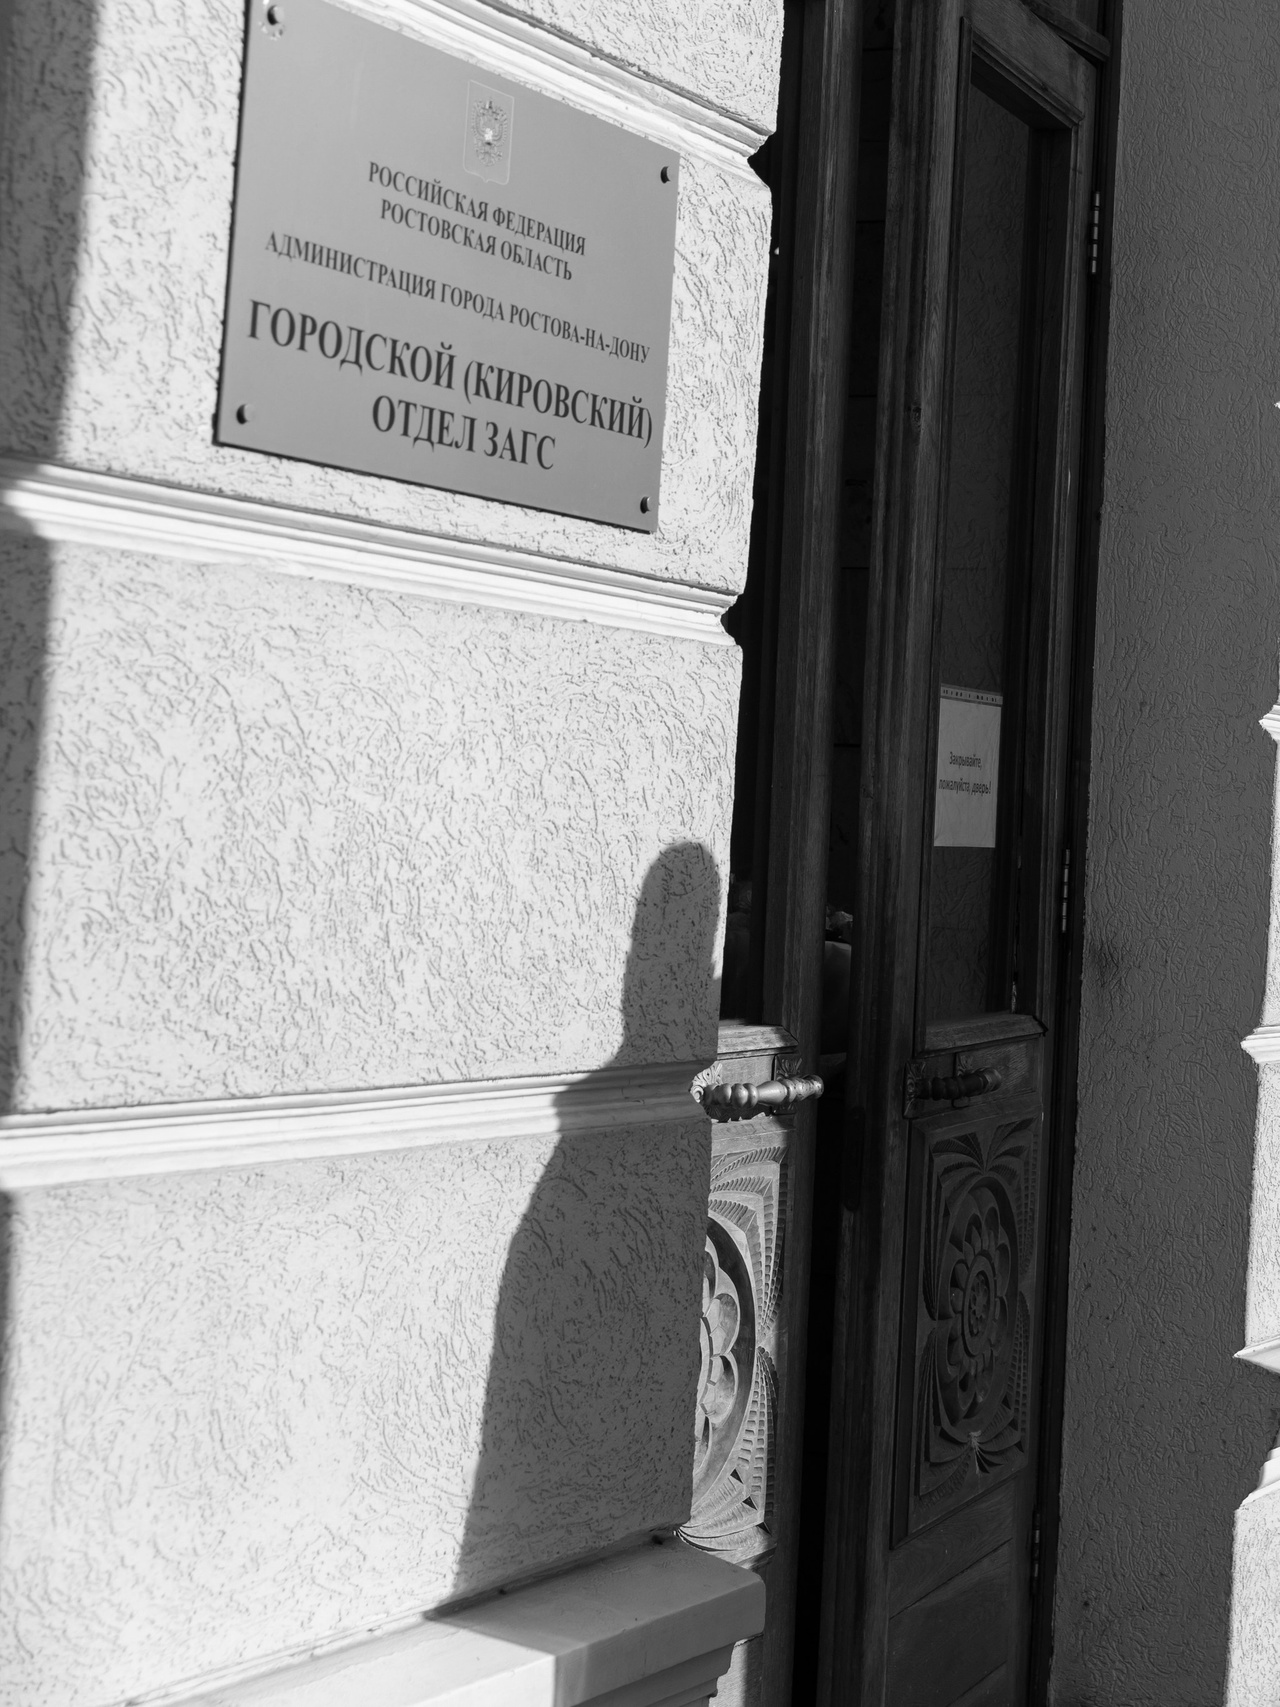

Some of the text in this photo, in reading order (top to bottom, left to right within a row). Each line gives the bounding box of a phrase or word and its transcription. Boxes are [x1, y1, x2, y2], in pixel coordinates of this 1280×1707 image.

[368, 161, 586, 256] РОССИЙСКАЯ ФЕДЕРАЦИЯ
[379, 199, 572, 281] РОСТОВСКАЯ ОБЛАСТЬ
[265, 231, 650, 364] АДМИНИСТРАЦИЯ ГОРОДА РОСТОВА-НА-ДОНУ
[248, 299, 652, 449] ГОРОДСКОЙ (КИРОВСКИЙ)
[372, 395, 556, 470] ОТДЕЛ ЗАГС
[938, 778, 992, 797] пожалуйста, дверь!
[949, 751, 982, 770] Закрывайте,
